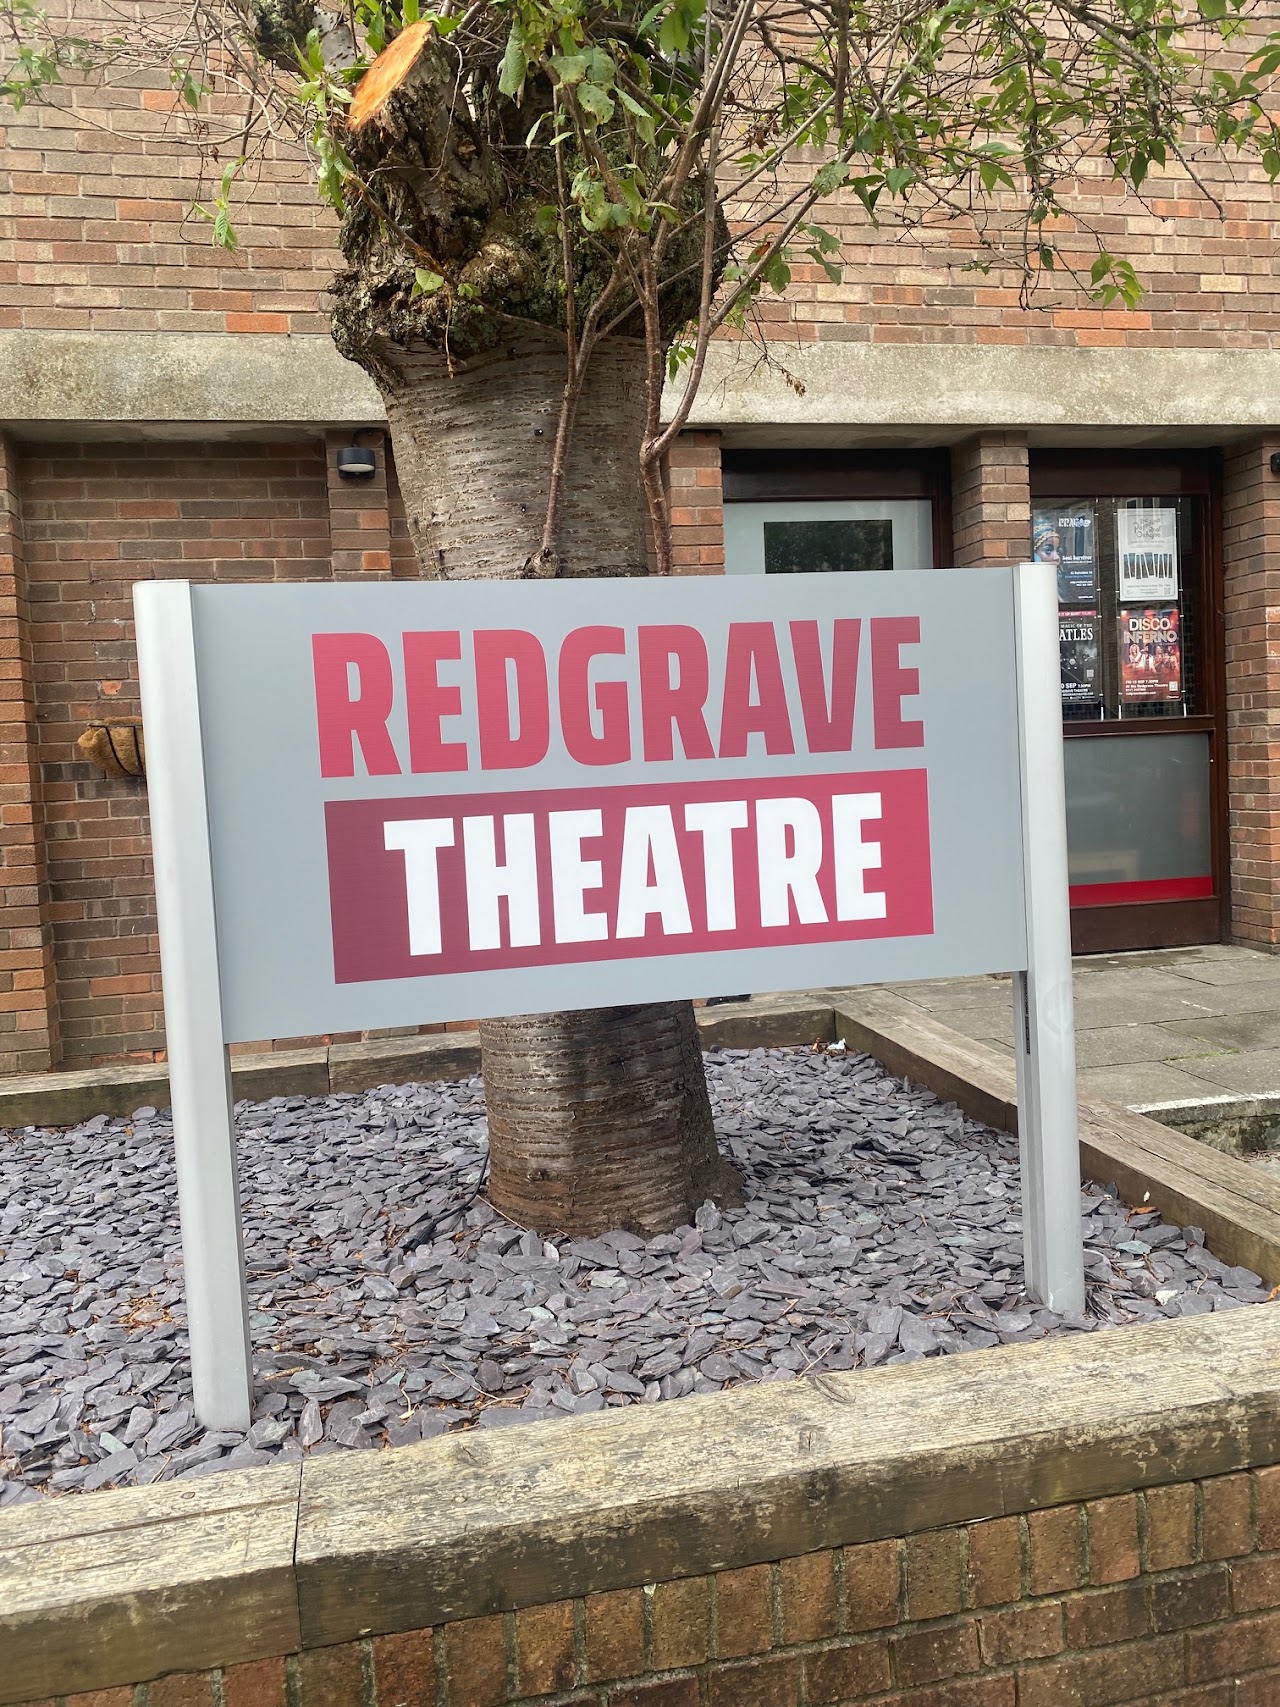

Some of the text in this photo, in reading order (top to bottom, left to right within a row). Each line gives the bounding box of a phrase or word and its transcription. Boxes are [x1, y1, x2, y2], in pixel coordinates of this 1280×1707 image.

[1129, 617, 1171, 631] DISCO
[1059, 628, 1094, 641] ATLES
[1124, 630, 1178, 644] INFERNO
[312, 616, 925, 778] REDGRAVE
[382, 791, 887, 957] THEATRE
